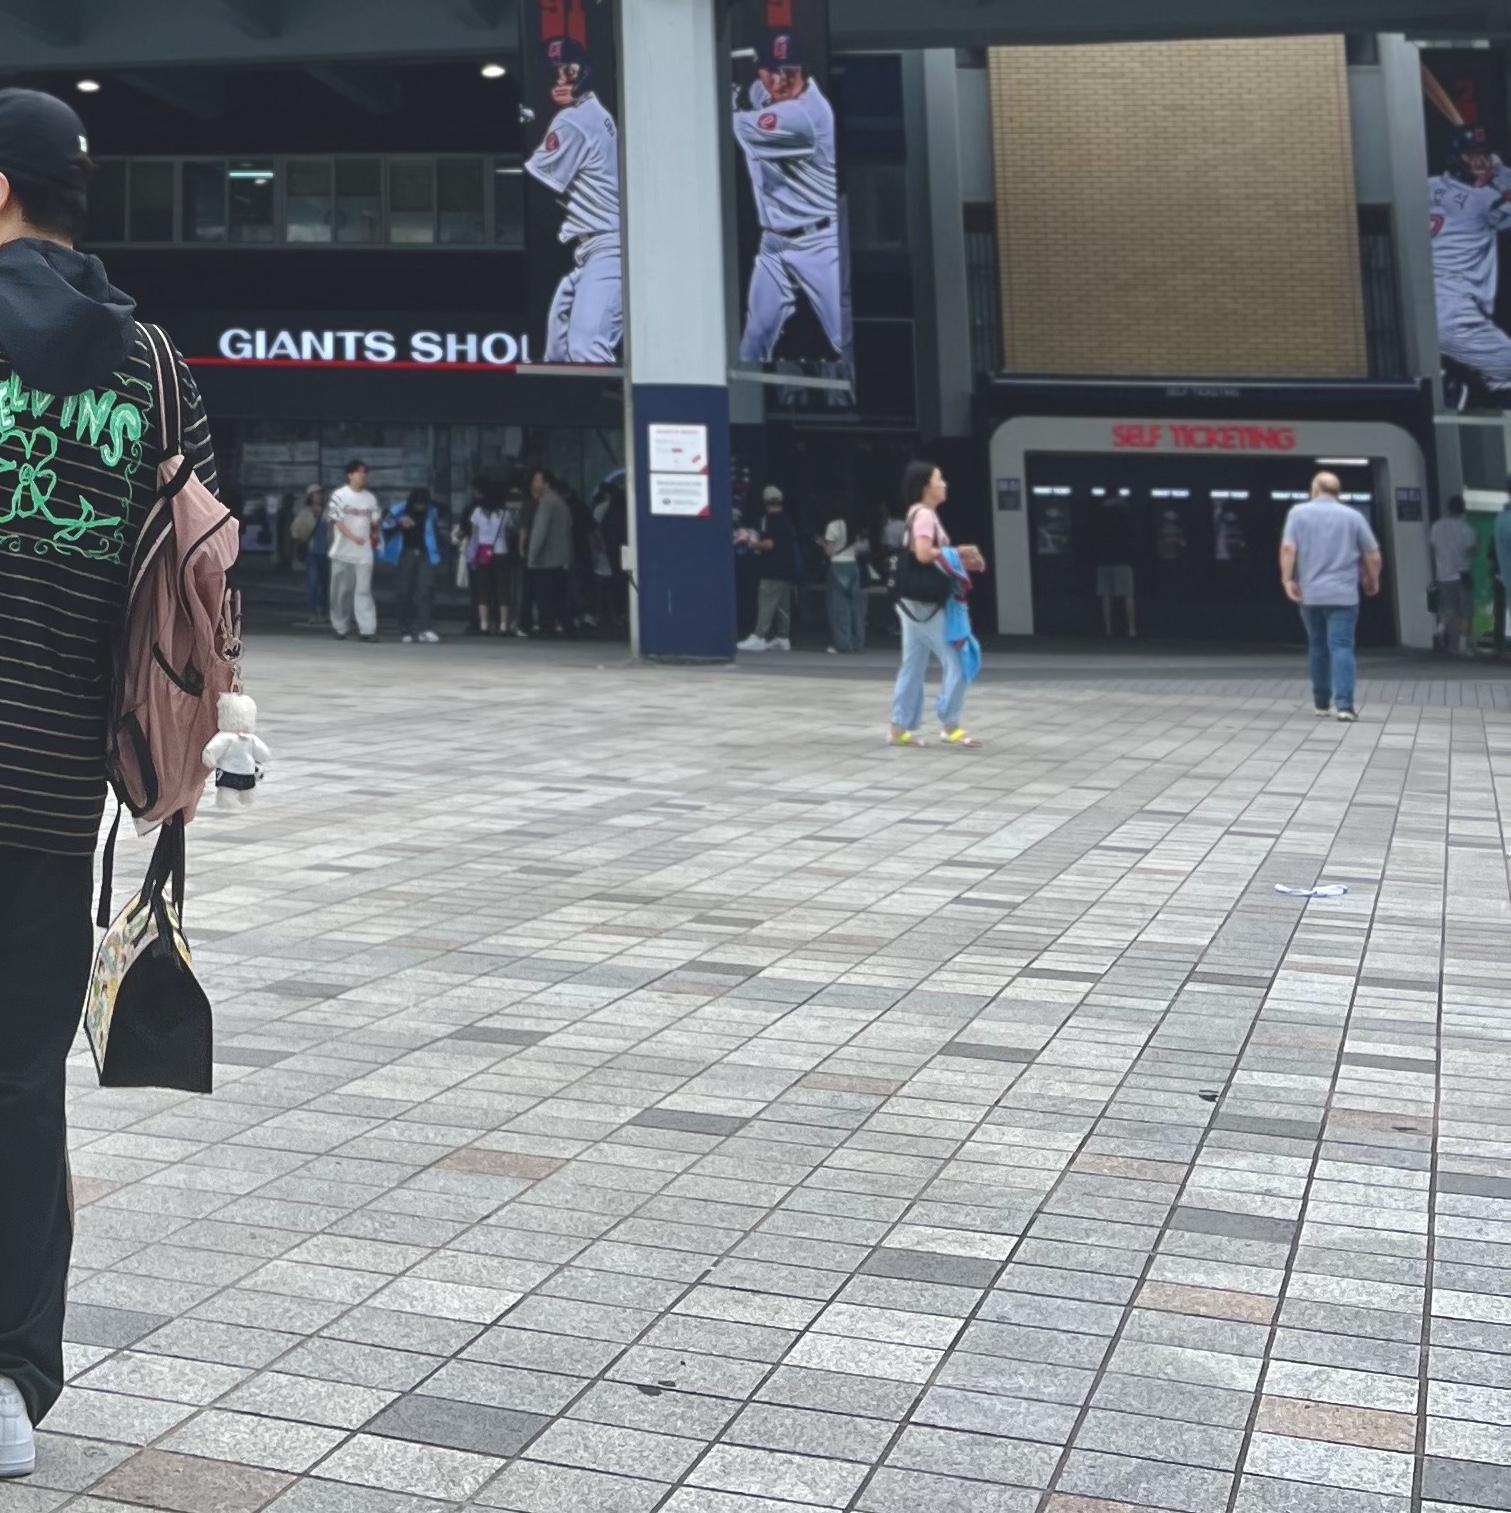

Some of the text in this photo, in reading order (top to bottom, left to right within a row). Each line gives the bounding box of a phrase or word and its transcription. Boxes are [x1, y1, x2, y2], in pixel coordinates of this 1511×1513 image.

[219, 329, 396, 362] GIANTS
[1112, 423, 1297, 451] SELF TICKETING
